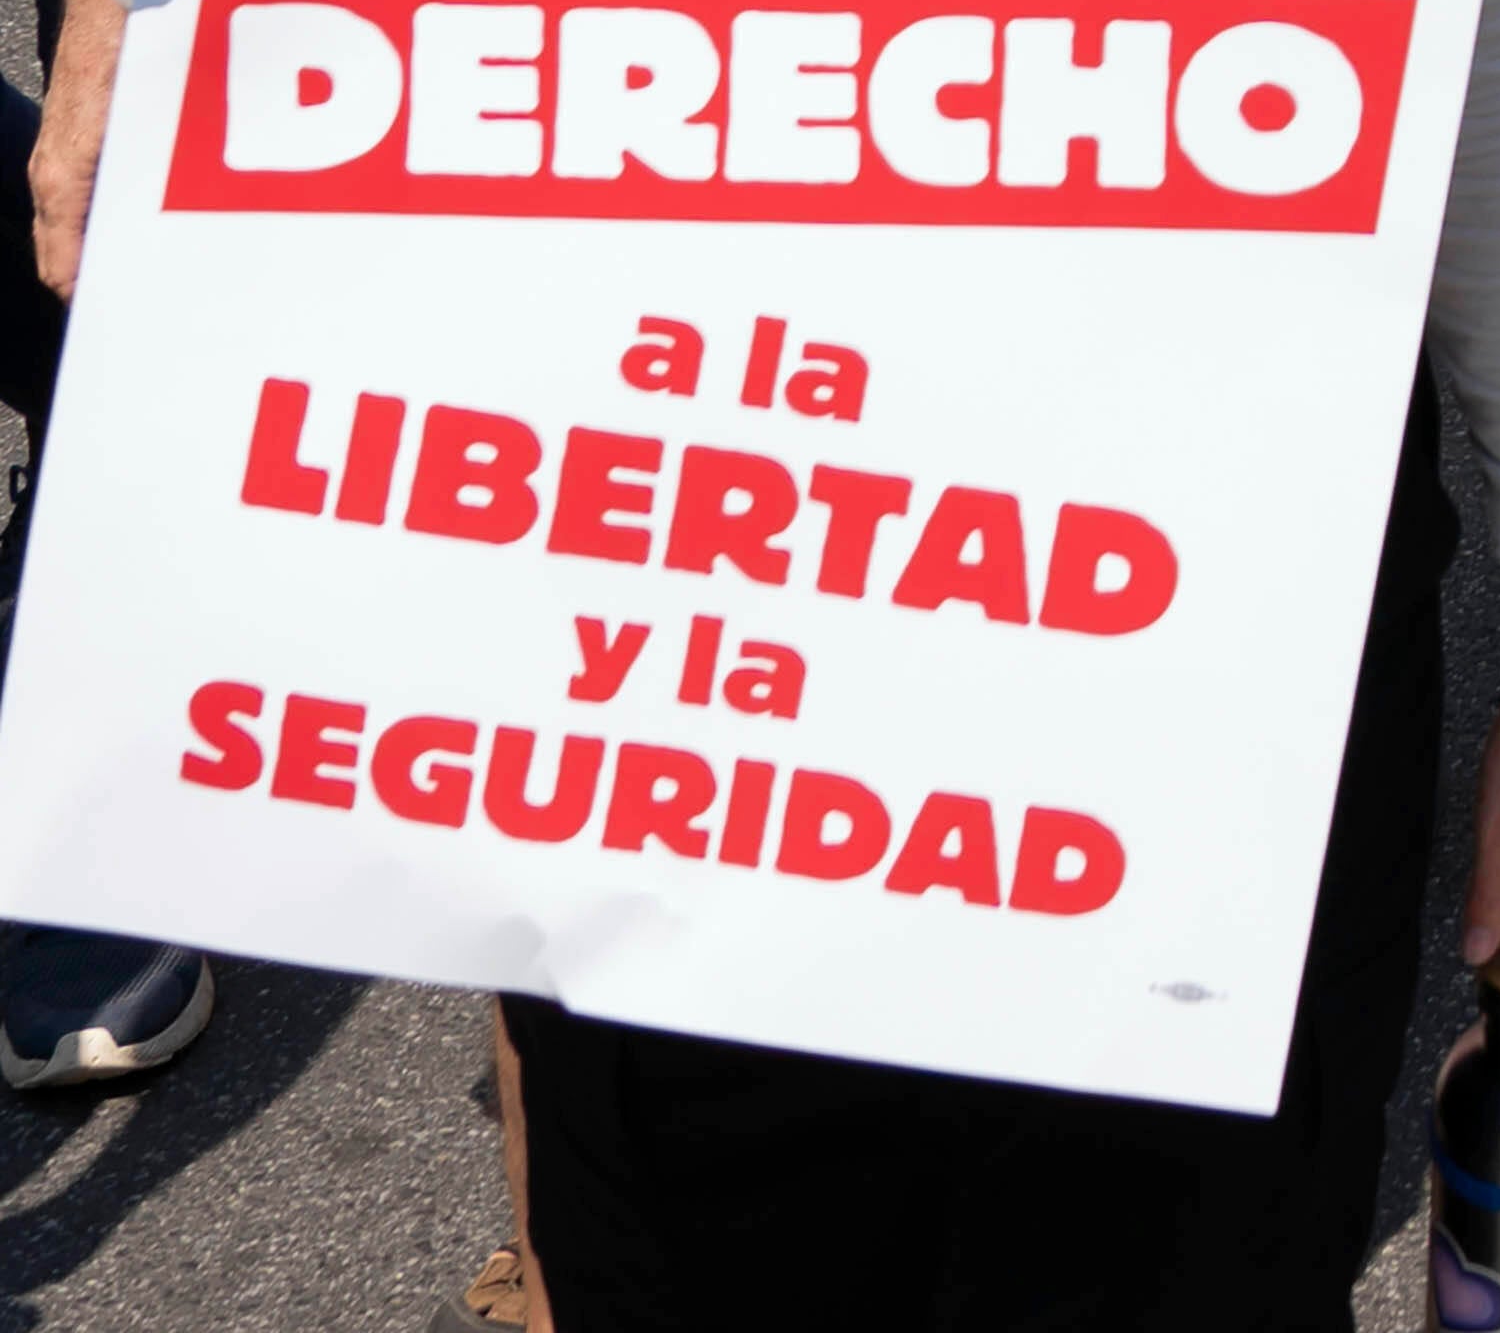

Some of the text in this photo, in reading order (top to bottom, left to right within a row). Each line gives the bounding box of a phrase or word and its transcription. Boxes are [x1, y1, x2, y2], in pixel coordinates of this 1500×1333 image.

[619, 314, 869, 424] a la
[240, 376, 1180, 638] LIBERTAD
[567, 616, 810, 721] y la
[178, 679, 1128, 917] SEGURIDAD
